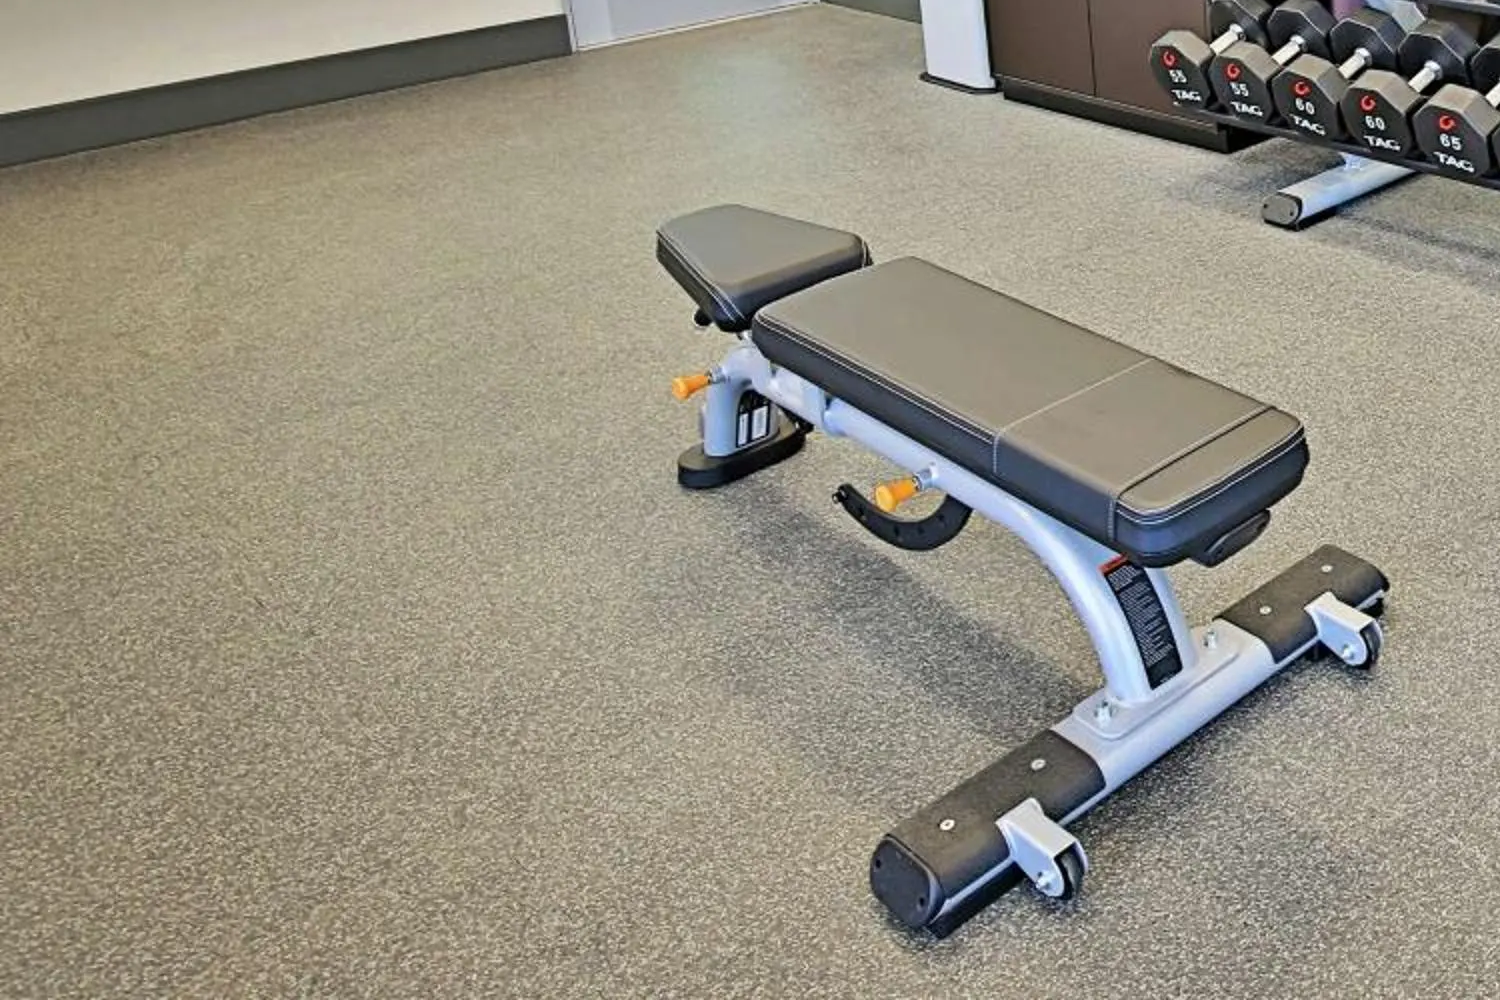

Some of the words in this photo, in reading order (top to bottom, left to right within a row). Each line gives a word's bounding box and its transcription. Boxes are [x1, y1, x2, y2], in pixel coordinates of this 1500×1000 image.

[1169, 69, 1187, 83] 55
[1171, 88, 1201, 102] TAG
[1231, 82, 1249, 97] 55
[1231, 102, 1263, 116] TAG
[1295, 98, 1315, 115] 60
[1290, 114, 1326, 136] TAG
[1365, 115, 1385, 131] 60
[1364, 135, 1400, 150] TAG
[1440, 133, 1462, 150] 65
[1434, 151, 1475, 173] TAG
